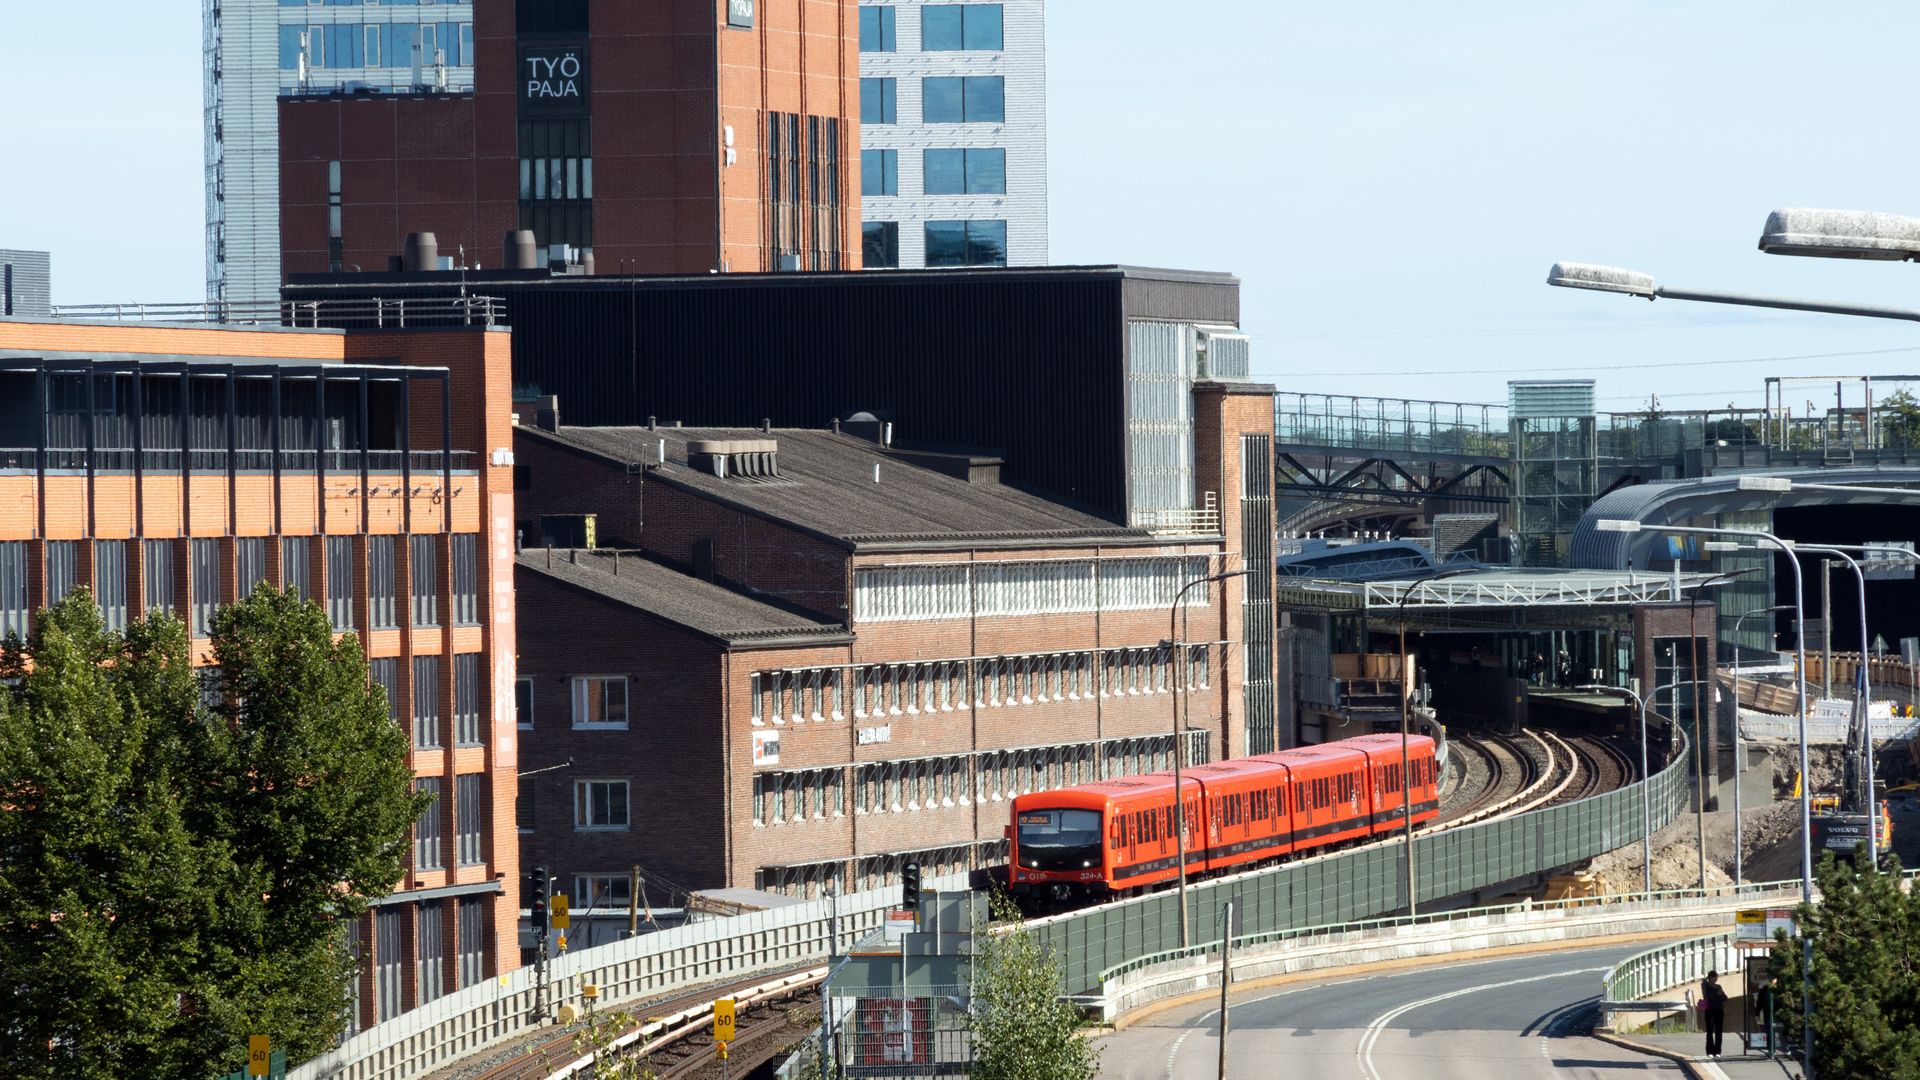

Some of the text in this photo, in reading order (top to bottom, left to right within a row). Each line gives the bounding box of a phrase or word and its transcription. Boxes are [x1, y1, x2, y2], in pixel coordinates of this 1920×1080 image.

[526, 53, 580, 78] TYÖ
[527, 80, 579, 98] PAJA
[1080, 872, 1103, 880] 324-A
[554, 907, 566, 917] 60
[717, 1014, 731, 1026] 60
[252, 1050, 266, 1061] 60
